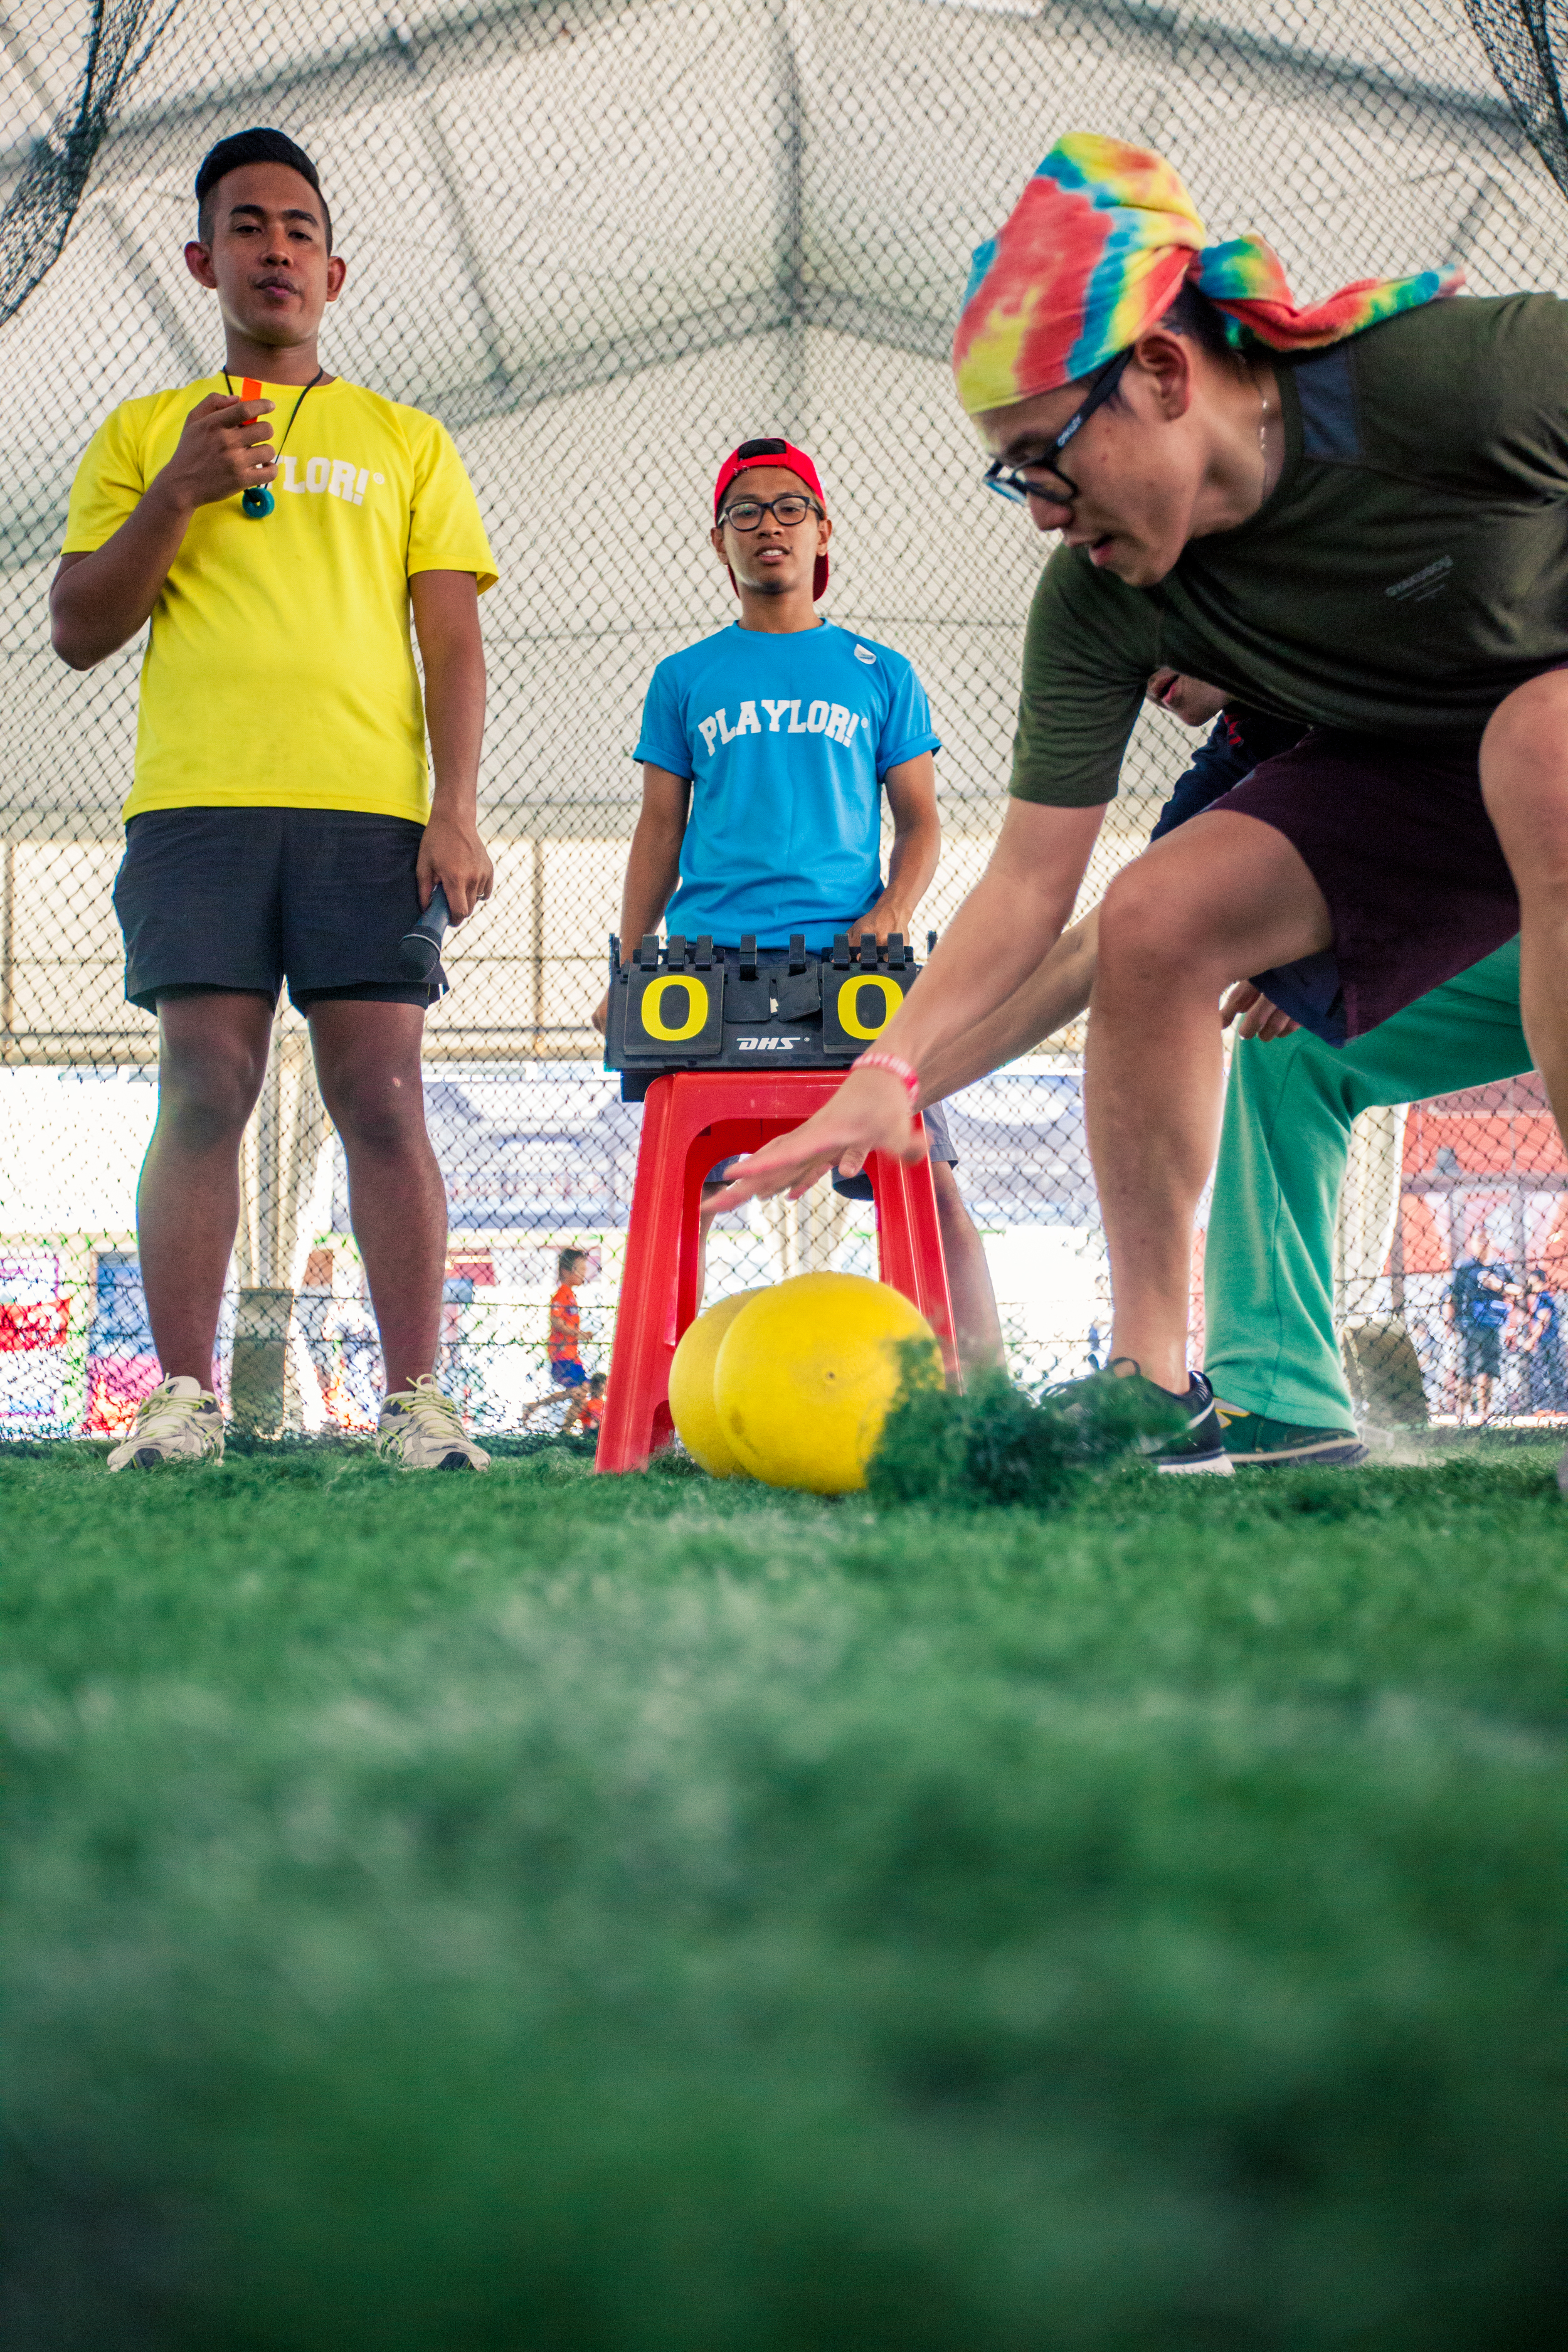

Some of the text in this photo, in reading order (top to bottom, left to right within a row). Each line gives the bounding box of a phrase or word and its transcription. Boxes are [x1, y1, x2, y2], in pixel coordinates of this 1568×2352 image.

[641, 975, 709, 1041] 0
[837, 974, 904, 1041] 0
[736, 1037, 802, 1051] DHS
